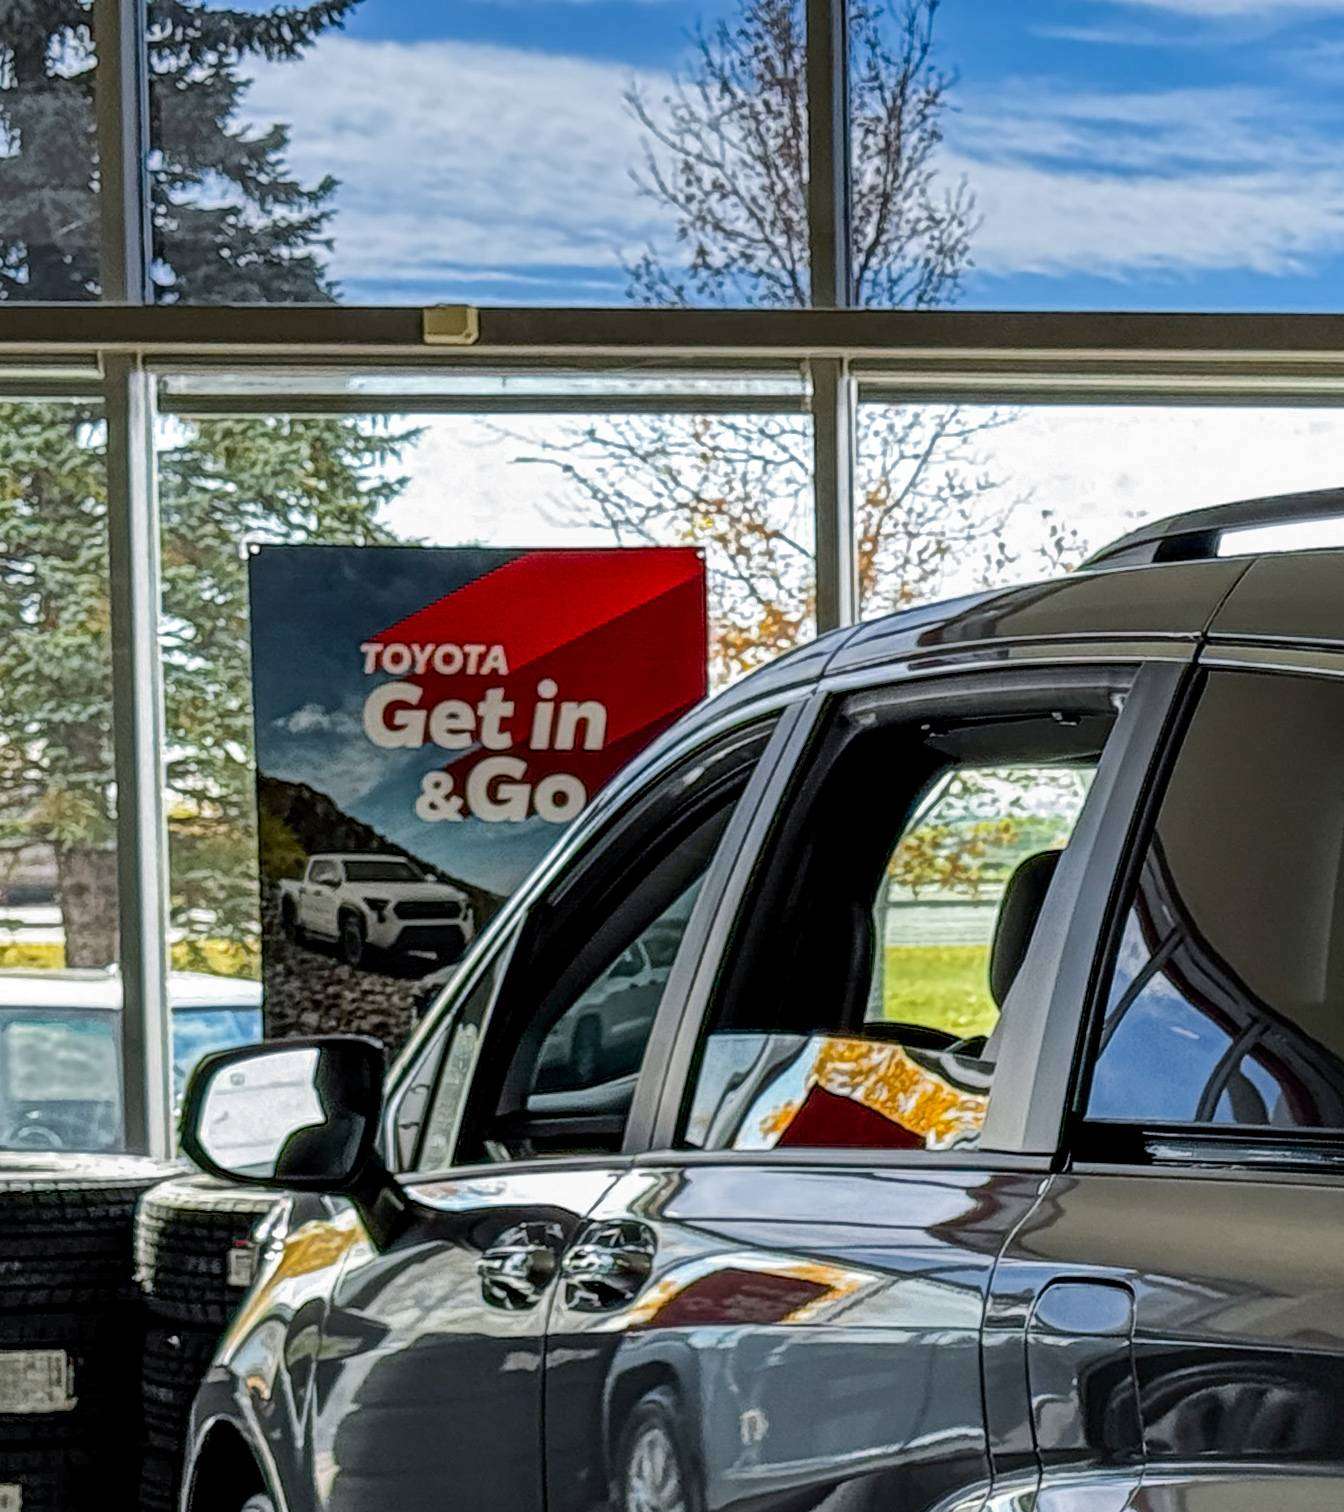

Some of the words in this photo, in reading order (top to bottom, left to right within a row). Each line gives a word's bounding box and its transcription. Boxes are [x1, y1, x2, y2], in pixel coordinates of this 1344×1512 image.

[360, 642, 509, 676] TOYOTA
[363, 681, 515, 751] Get
[530, 678, 608, 751] in
[415, 756, 588, 824] &Go
